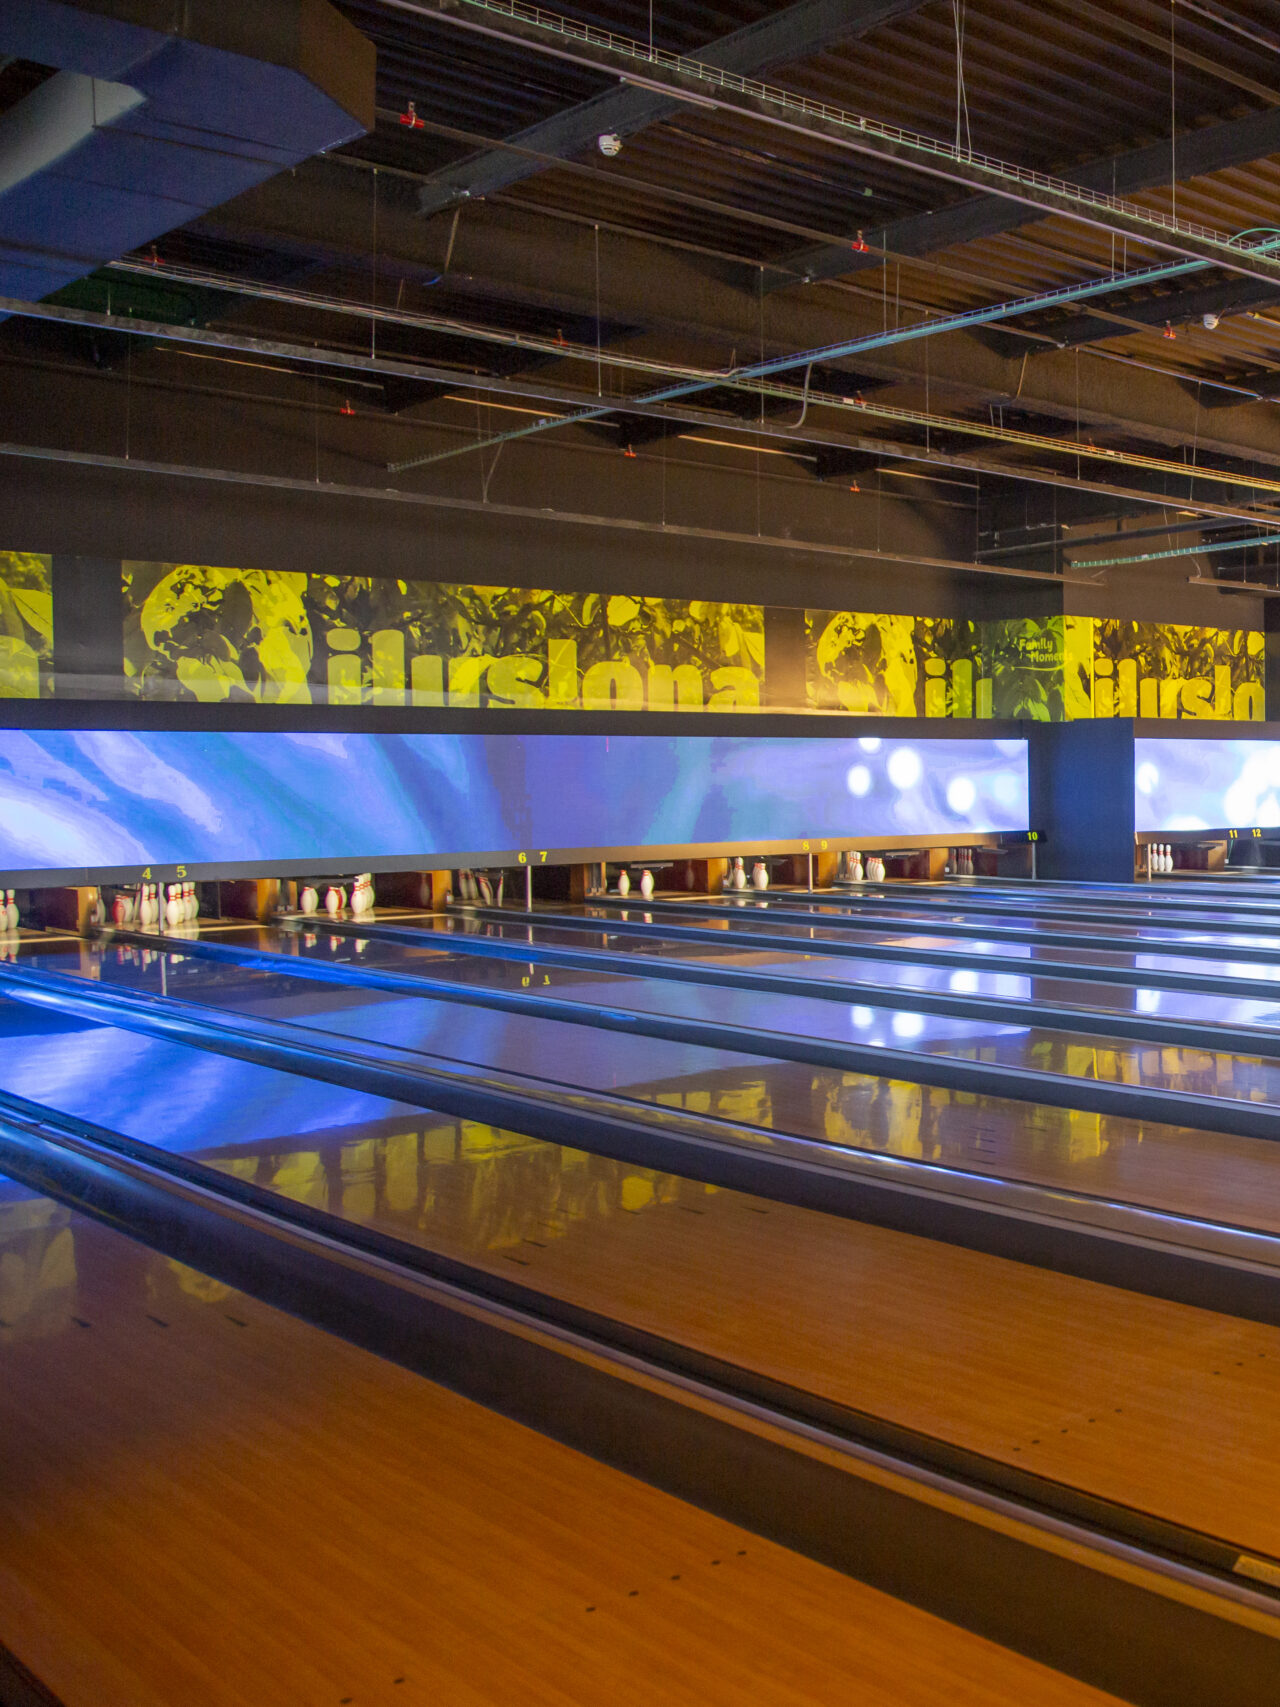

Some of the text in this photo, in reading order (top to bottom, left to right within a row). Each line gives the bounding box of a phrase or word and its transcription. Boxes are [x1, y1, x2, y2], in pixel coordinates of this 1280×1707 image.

[1027, 831, 1038, 841] 10
[1228, 828, 1262, 839] 11 12
[802, 840, 810, 851] 8
[518, 851, 548, 864] 6 7
[141, 865, 187, 880] 4 5
